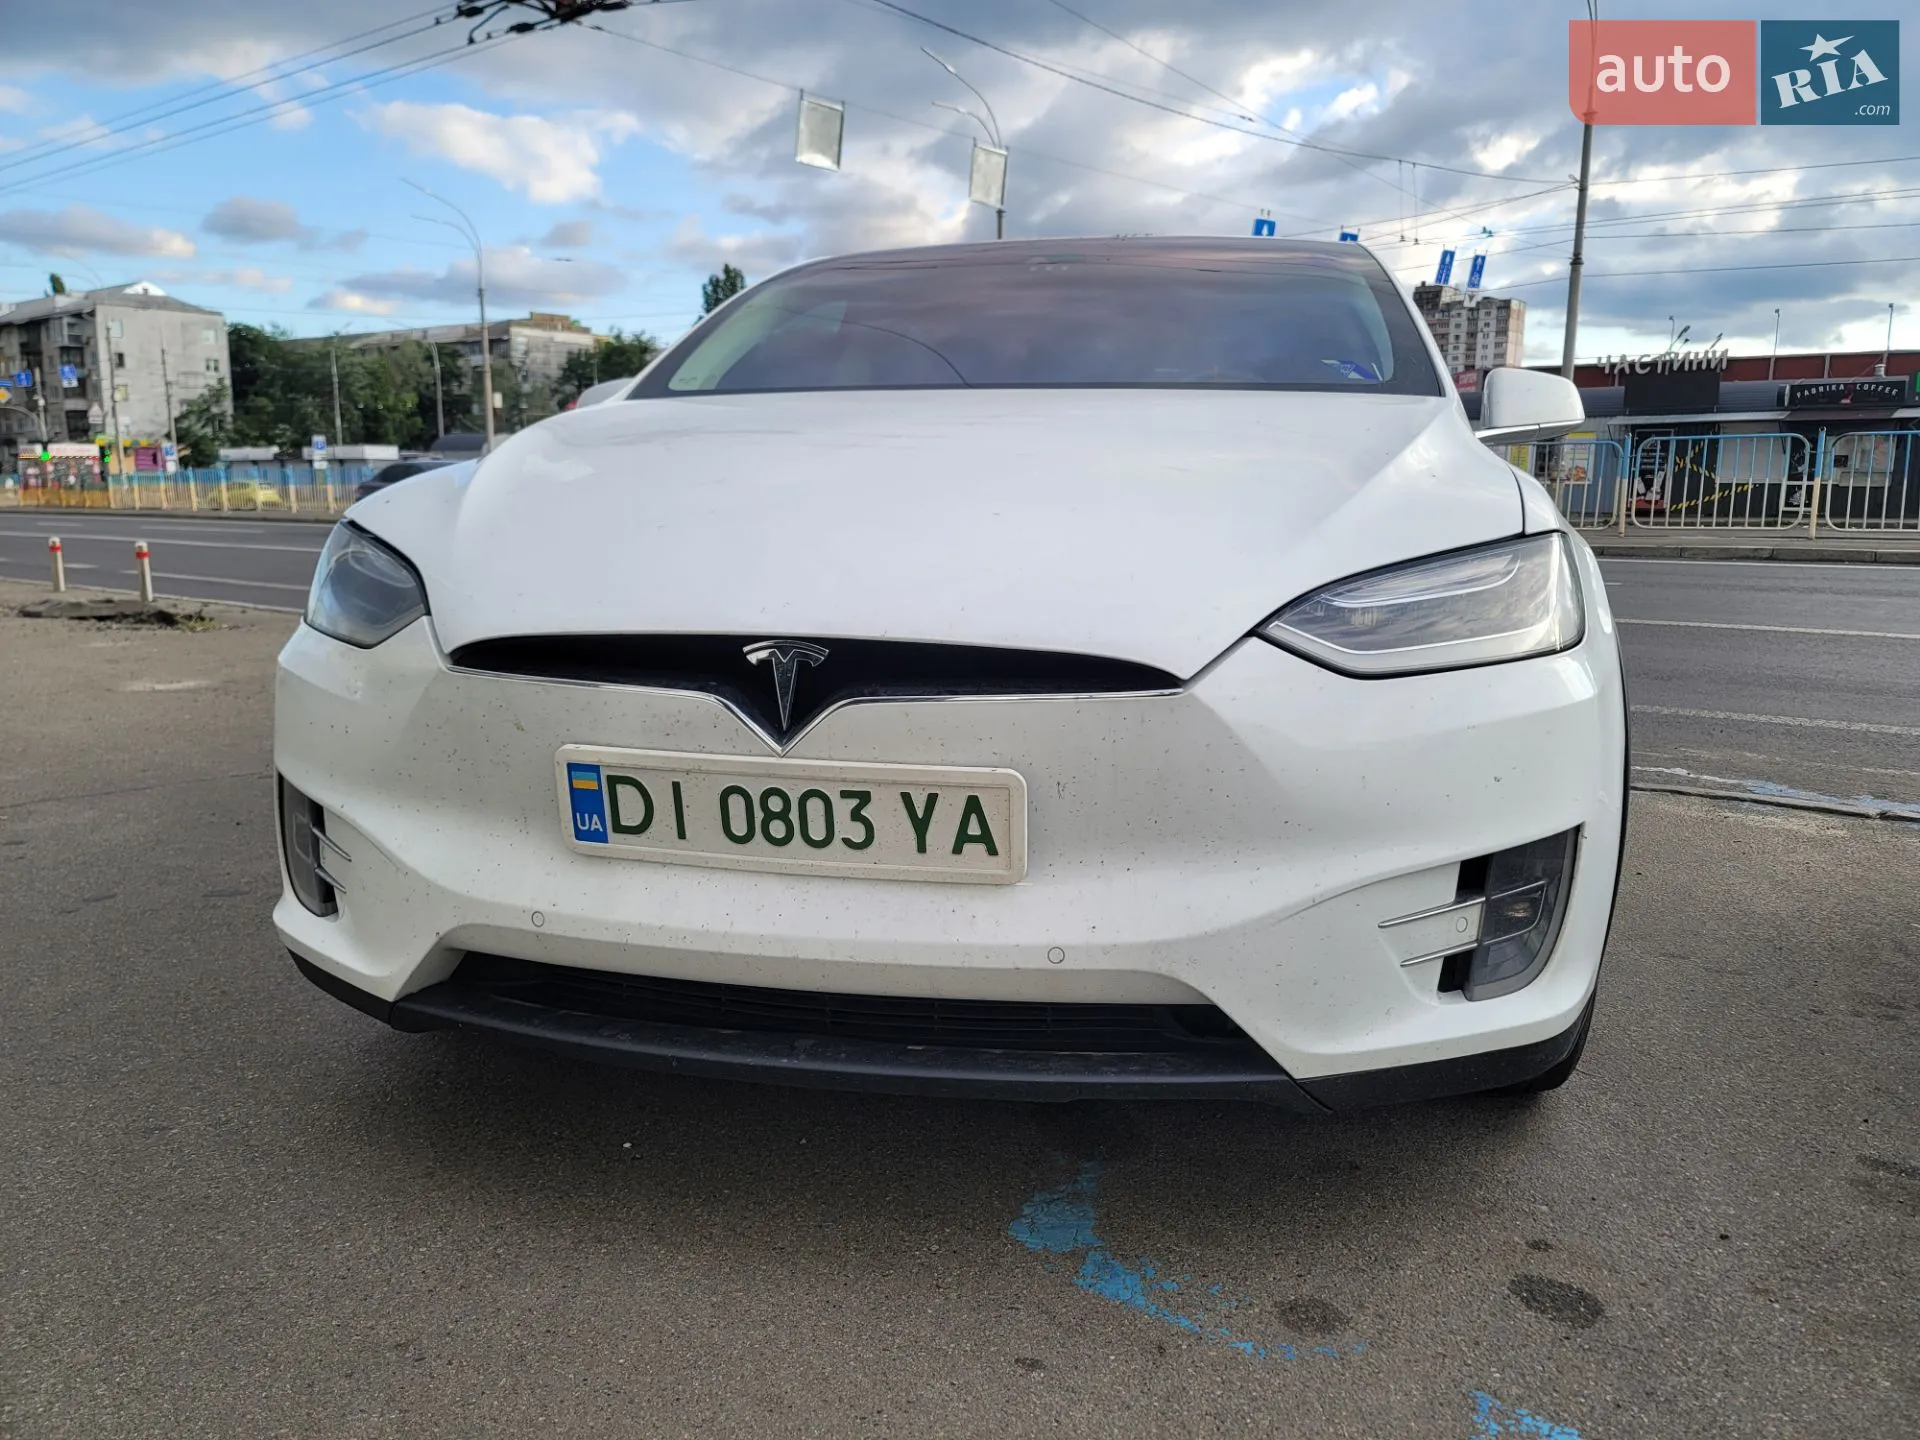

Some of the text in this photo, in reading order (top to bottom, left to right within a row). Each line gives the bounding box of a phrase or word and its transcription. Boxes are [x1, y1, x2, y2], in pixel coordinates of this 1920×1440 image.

[1597, 348, 1729, 375] ЧАСТИНИ
[1796, 383, 1899, 399] FABRIKA COFFEE
[576, 811, 604, 833] UA
[605, 774, 999, 856] DI 0803 YA
